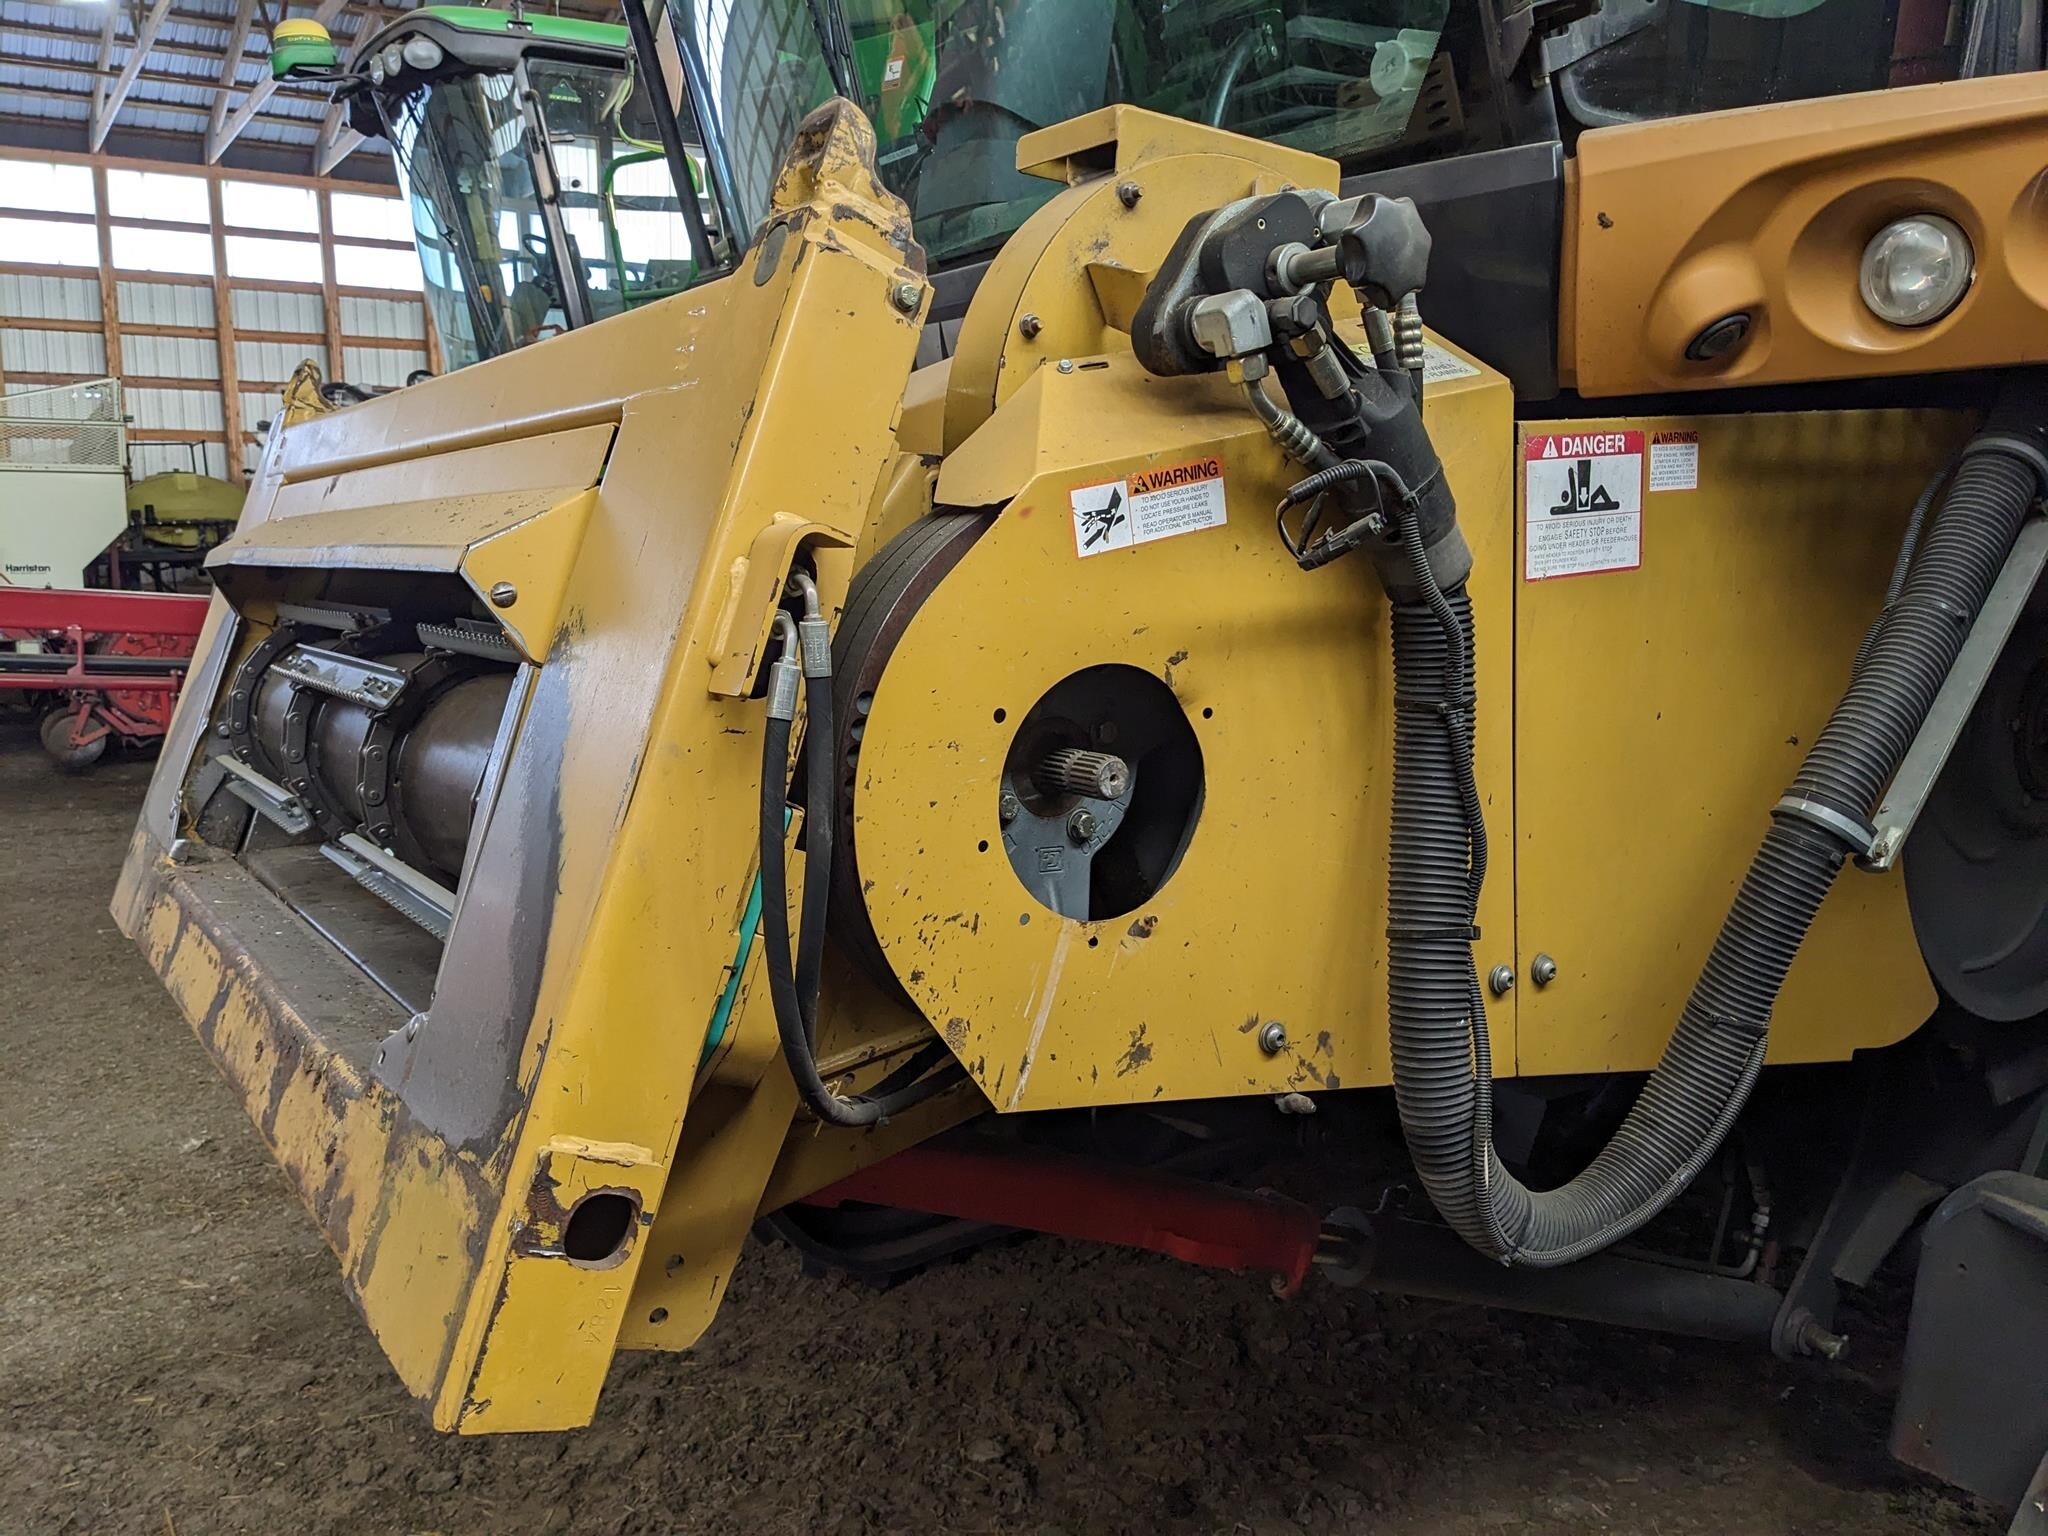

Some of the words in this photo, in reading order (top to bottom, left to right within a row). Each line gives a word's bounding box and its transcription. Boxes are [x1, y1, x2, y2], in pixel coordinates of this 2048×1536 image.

[1661, 431, 1698, 443] WARNING
[1562, 434, 1626, 456] DANGER
[1149, 460, 1218, 489] WARNING
[1167, 487, 1190, 499] SERIOUS
[1190, 484, 1208, 493] INJURY
[1149, 503, 1160, 511] NOT
[1161, 500, 1171, 508] USE
[1172, 498, 1185, 506] YOUR
[1186, 494, 1202, 502] HANDS
[1141, 510, 1162, 521] LOCATE
[1163, 504, 1191, 516] PRESSURE
[1143, 521, 1157, 529] READ
[1192, 509, 1213, 518] MANUAL
[1154, 522, 1182, 534] ADDITIONAL
[1562, 520, 1586, 528] SERIOUS
[1587, 518, 1605, 526] INJURY
[1616, 516, 1632, 524] DEATH
[1539, 533, 1562, 542] ENGAGE
[1564, 529, 1588, 540] SAFETY
[1590, 527, 1605, 538] STOP
[1606, 527, 1627, 535] BEFORE
[1529, 544, 1547, 552] GOING
[1548, 542, 1567, 550] UNDER
[1568, 539, 1591, 548] HEADER
[6, 564, 51, 572] Harriston
